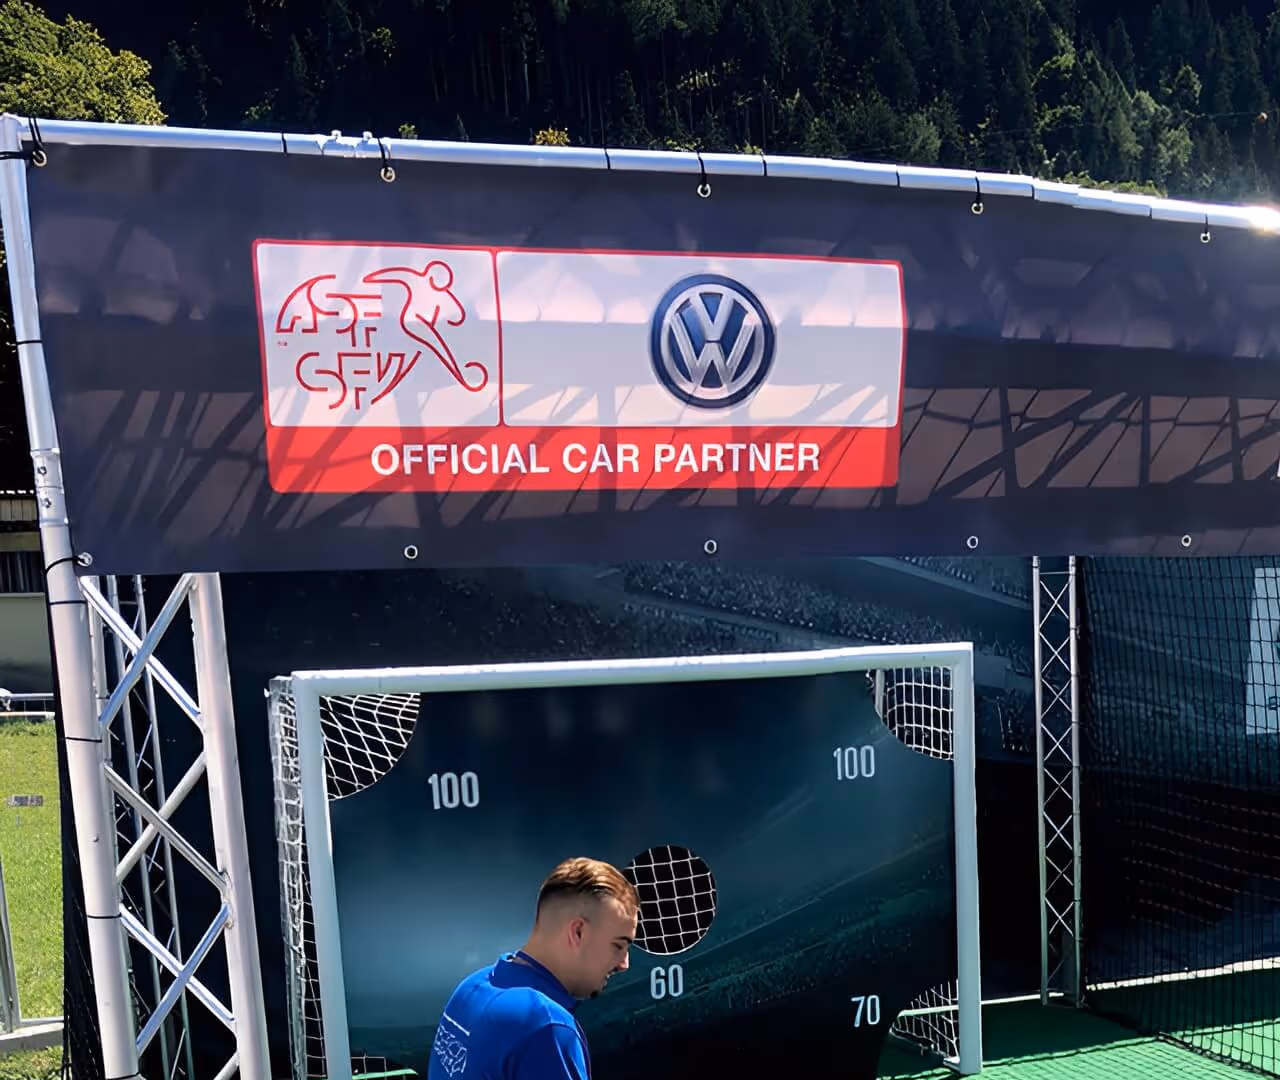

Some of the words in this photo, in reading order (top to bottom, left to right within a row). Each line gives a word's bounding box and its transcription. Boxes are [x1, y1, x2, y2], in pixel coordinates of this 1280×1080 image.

[370, 443, 549, 476] OFFICIAL
[562, 443, 640, 474] CAR
[654, 443, 821, 473] PARTNER
[833, 745, 876, 781] 100
[428, 771, 480, 811] 100
[650, 964, 684, 1000] 60
[851, 994, 881, 1028] 70
